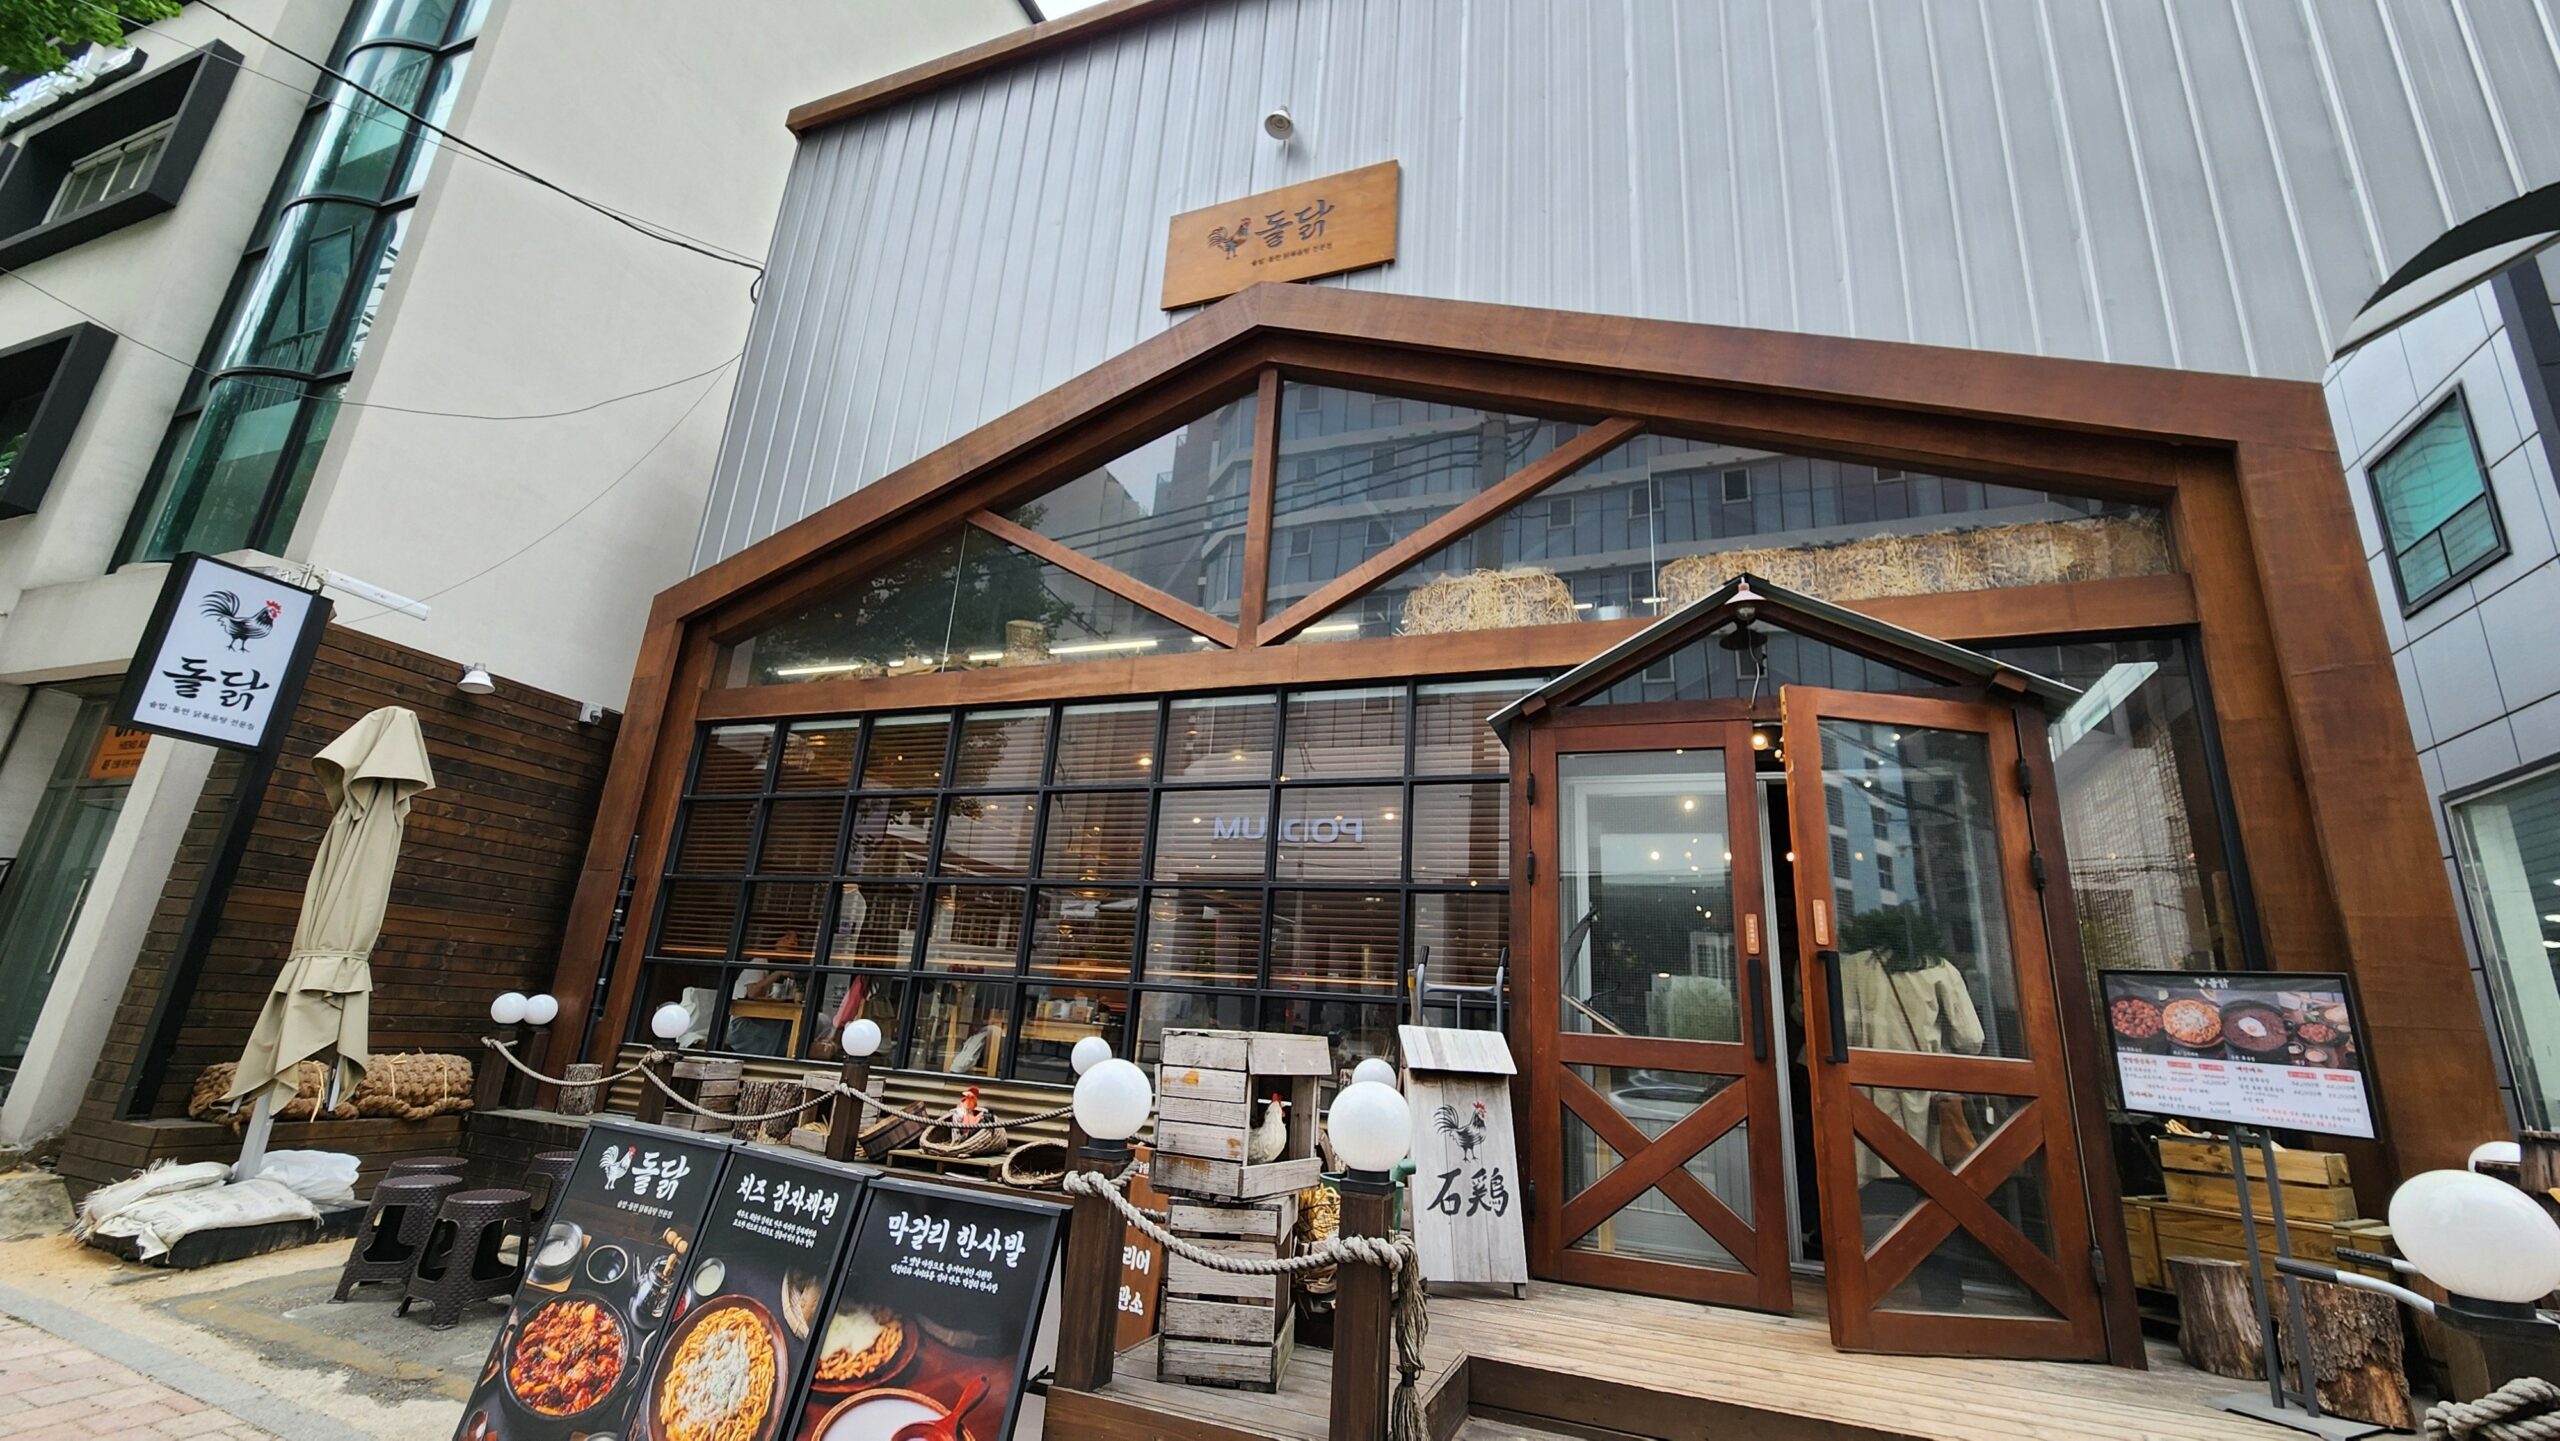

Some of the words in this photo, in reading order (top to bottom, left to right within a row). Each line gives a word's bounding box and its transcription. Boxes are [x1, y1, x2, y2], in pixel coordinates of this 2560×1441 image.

[1254, 200, 1335, 248] 돌닭
[162, 656, 270, 711] 돌닭
[632, 1152, 690, 1201] 돌닭
[736, 1173, 767, 1203] 치즈
[772, 1180, 840, 1226] 감자채전
[888, 1211, 950, 1252] 막걸리
[956, 1224, 1026, 1268] 한사발
